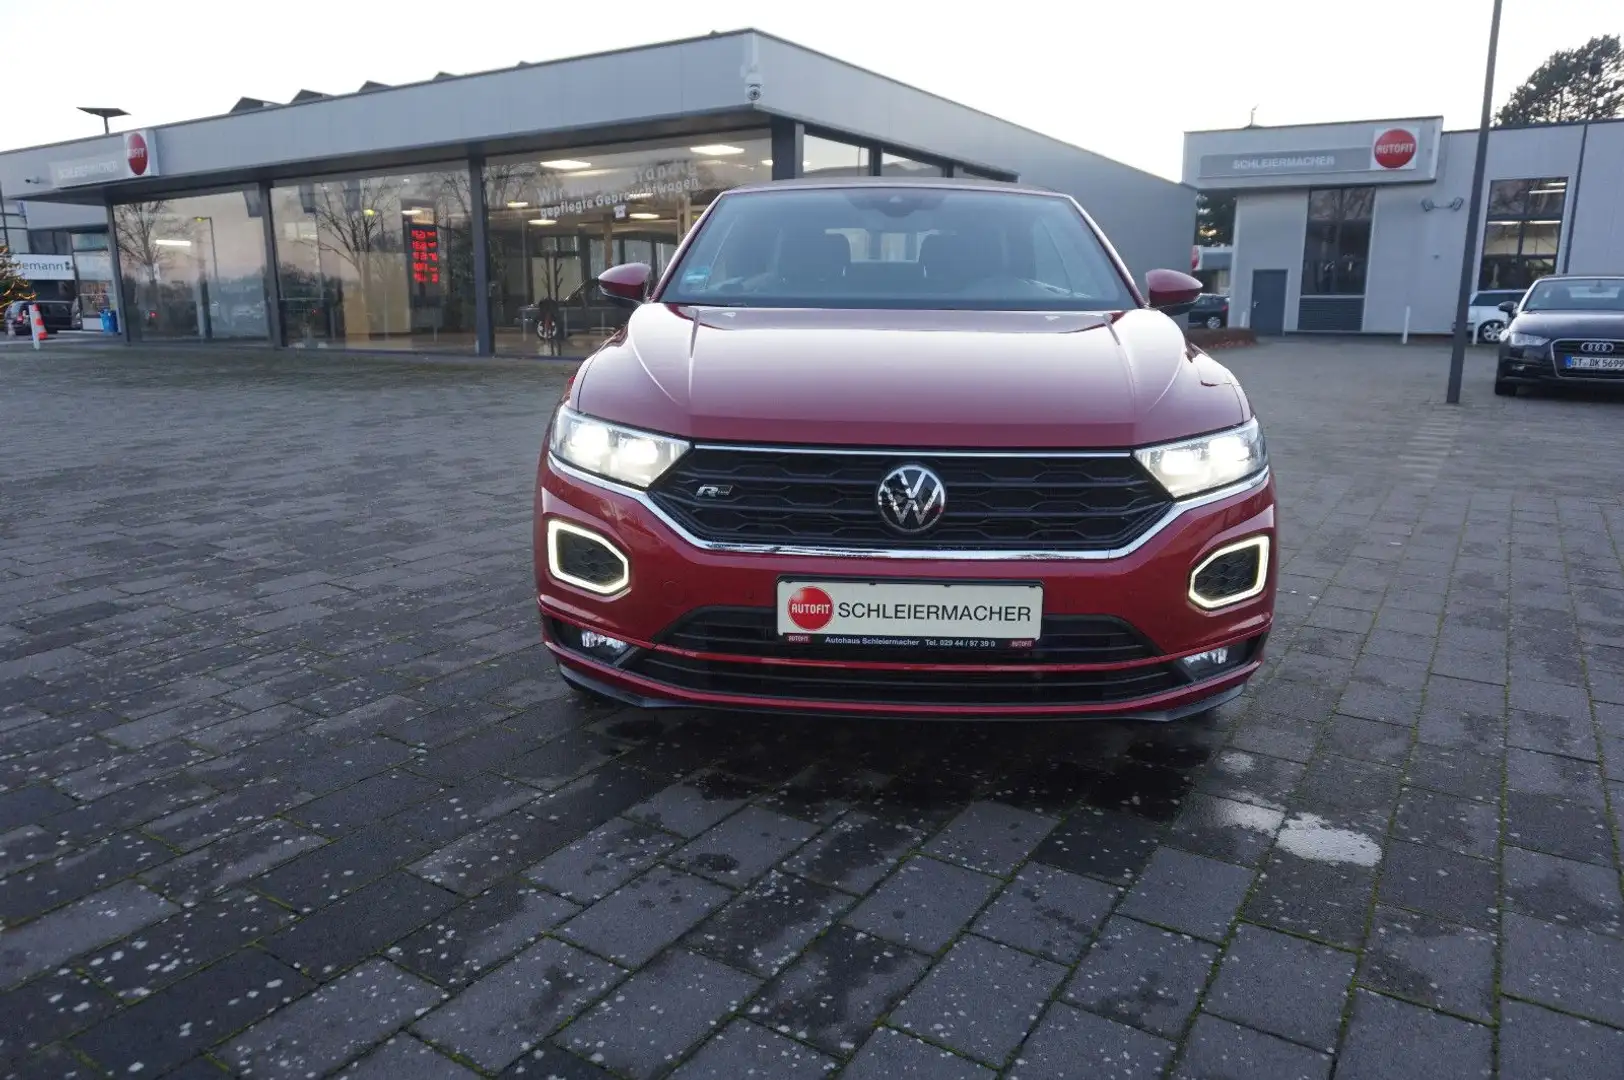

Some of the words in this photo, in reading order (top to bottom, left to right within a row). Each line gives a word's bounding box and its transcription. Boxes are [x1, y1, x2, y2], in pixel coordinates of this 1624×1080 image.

[1375, 143, 1415, 154] AUTOFIT
[1233, 155, 1335, 169] SCHLEIERMACHER
[791, 603, 831, 615] AUTOFIT
[838, 602, 1032, 622] SCHLEIERMACHER
[825, 636, 860, 645] Autohaus
[861, 637, 920, 646] Schleiermacher
